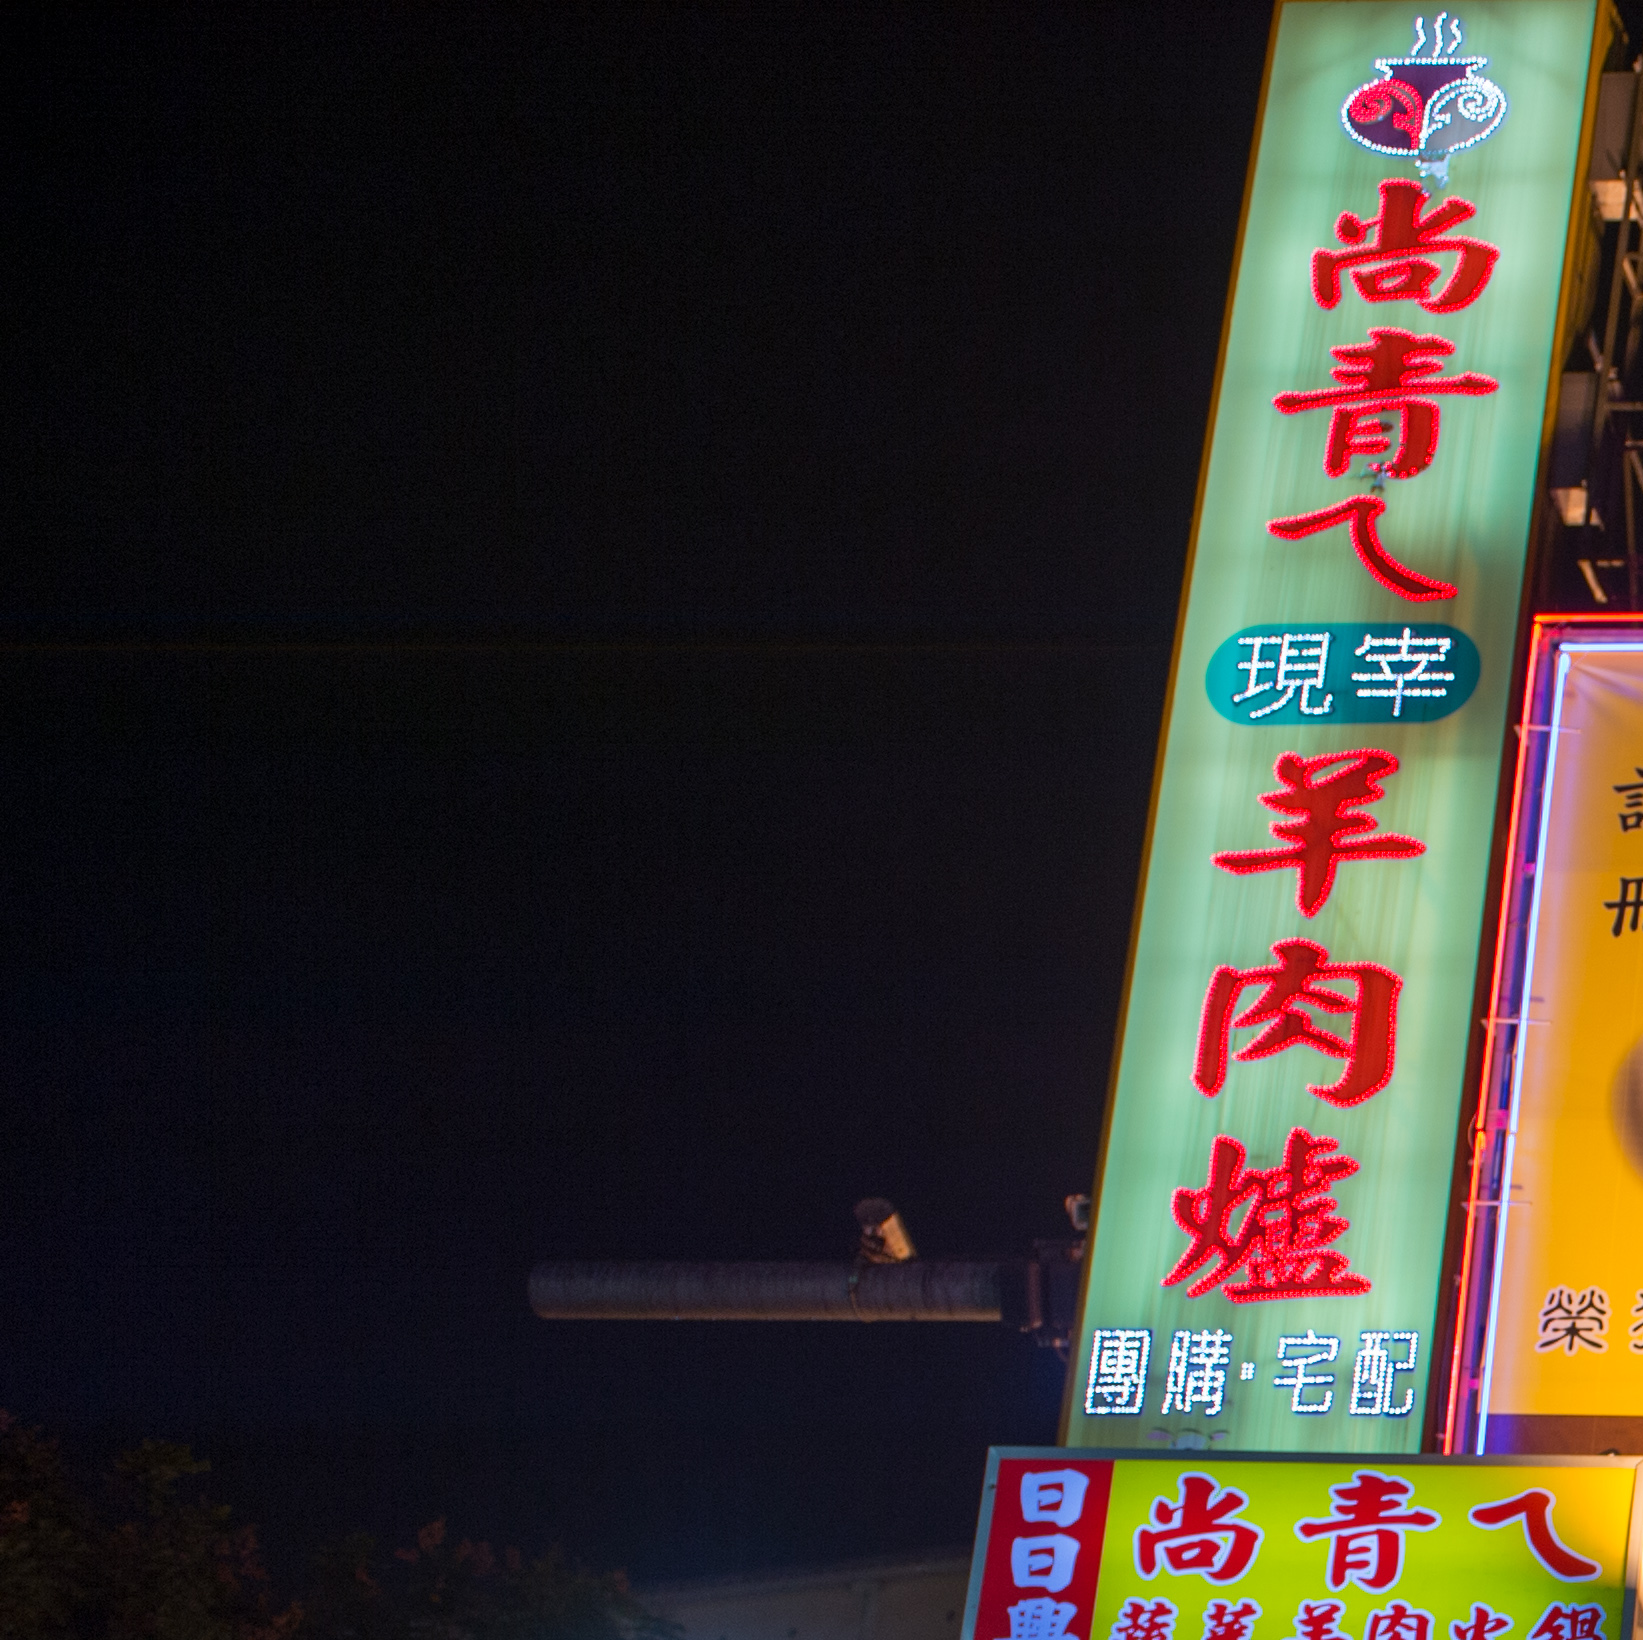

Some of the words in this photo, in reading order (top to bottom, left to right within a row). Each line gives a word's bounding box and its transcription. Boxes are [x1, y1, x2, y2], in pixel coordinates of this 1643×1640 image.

[1231, 628, 1456, 718] 現宰
[1161, 747, 1427, 1305] 羊肉爐
